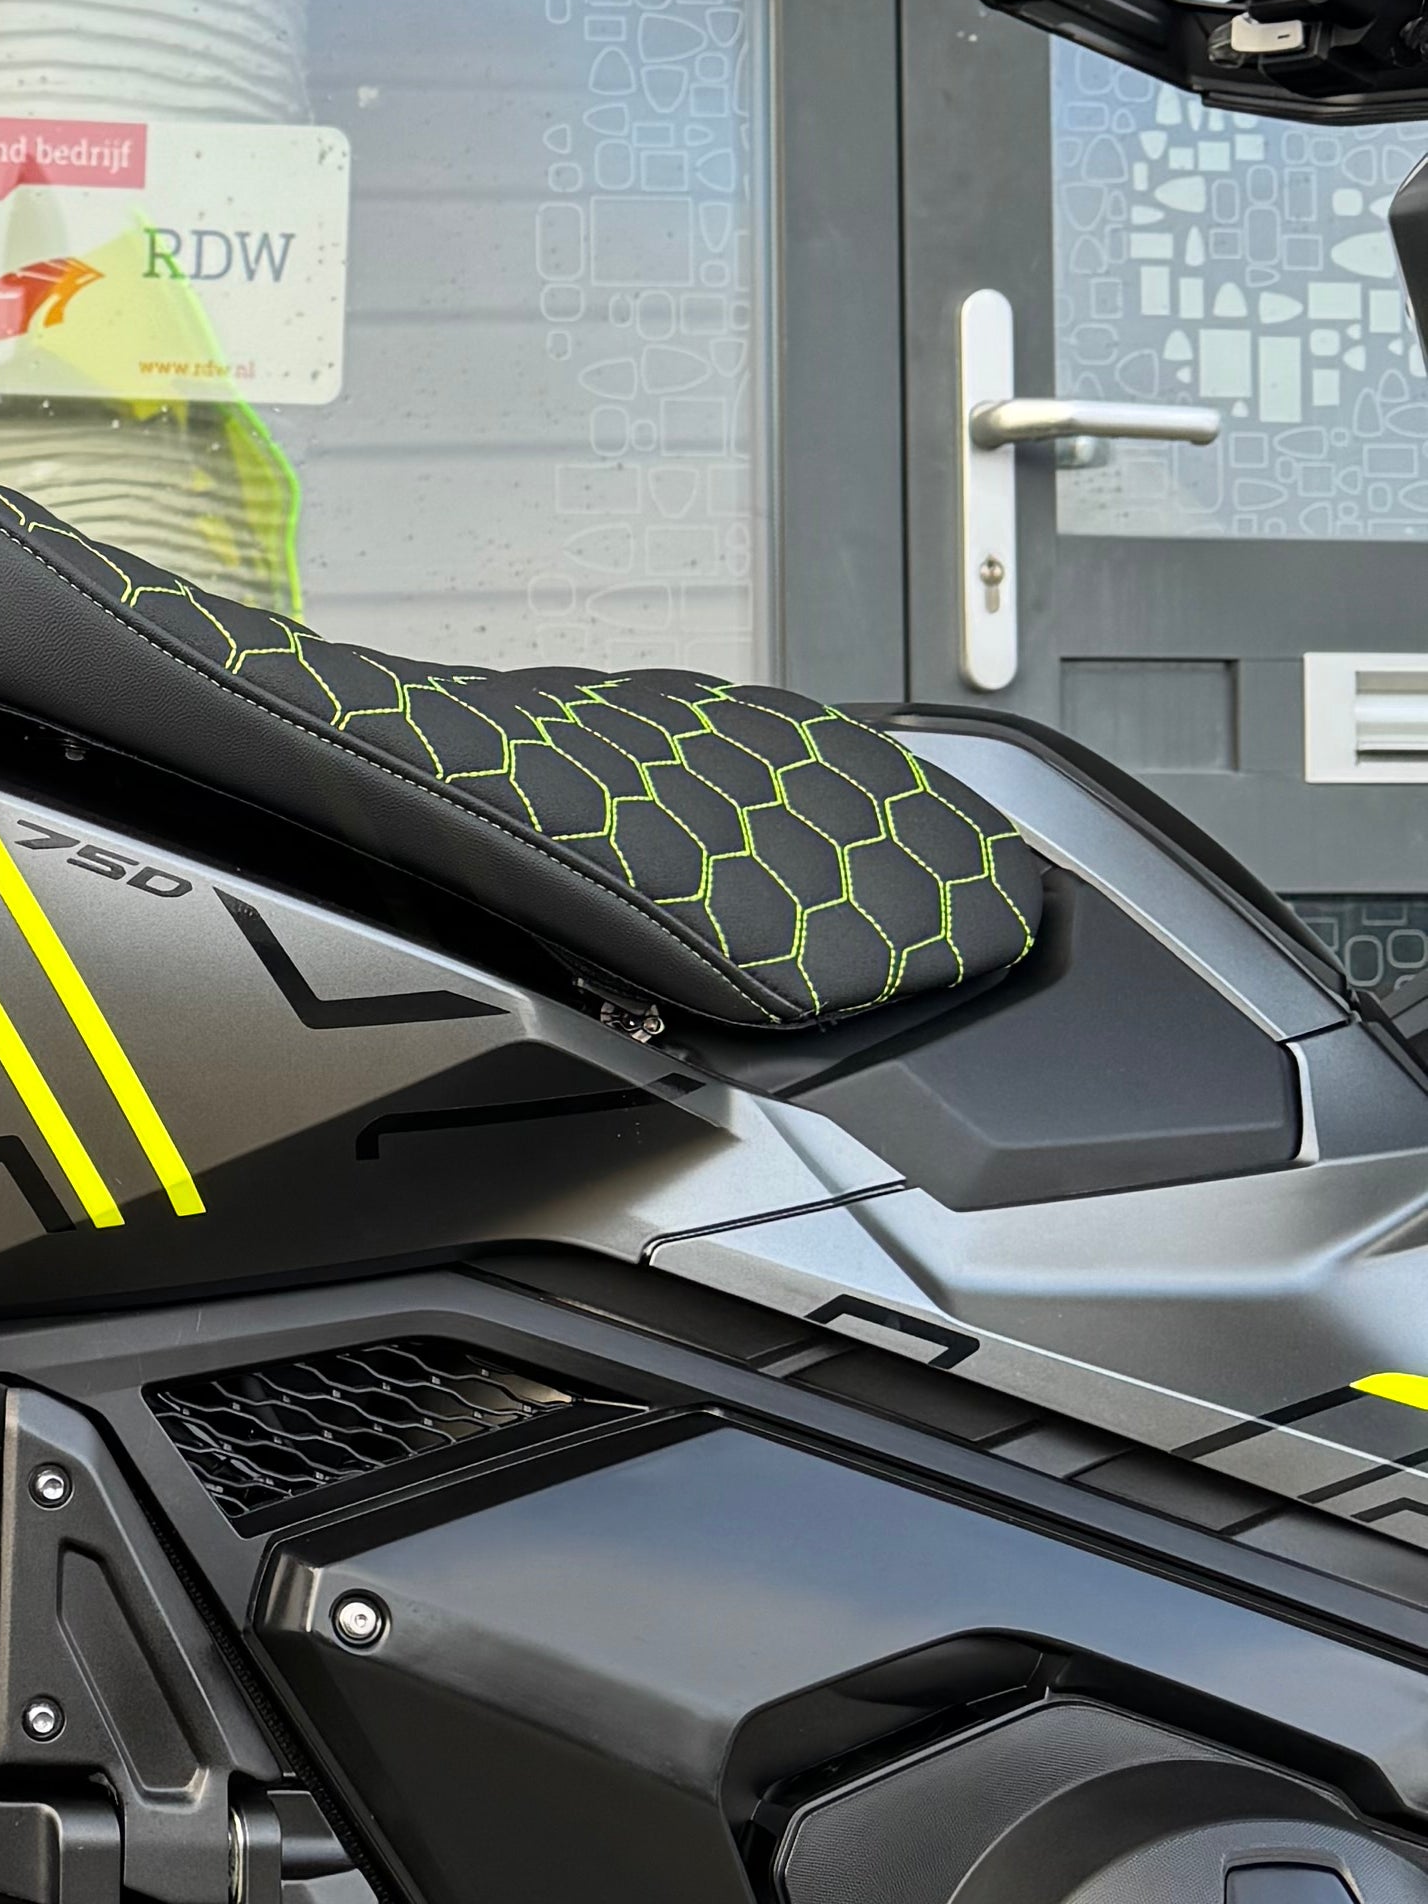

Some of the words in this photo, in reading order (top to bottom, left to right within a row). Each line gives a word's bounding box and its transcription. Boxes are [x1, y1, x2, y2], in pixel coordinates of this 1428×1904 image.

[35, 134, 133, 174] bedrijf
[142, 227, 297, 283] RDW
[138, 358, 256, 380] www.rdw.nl
